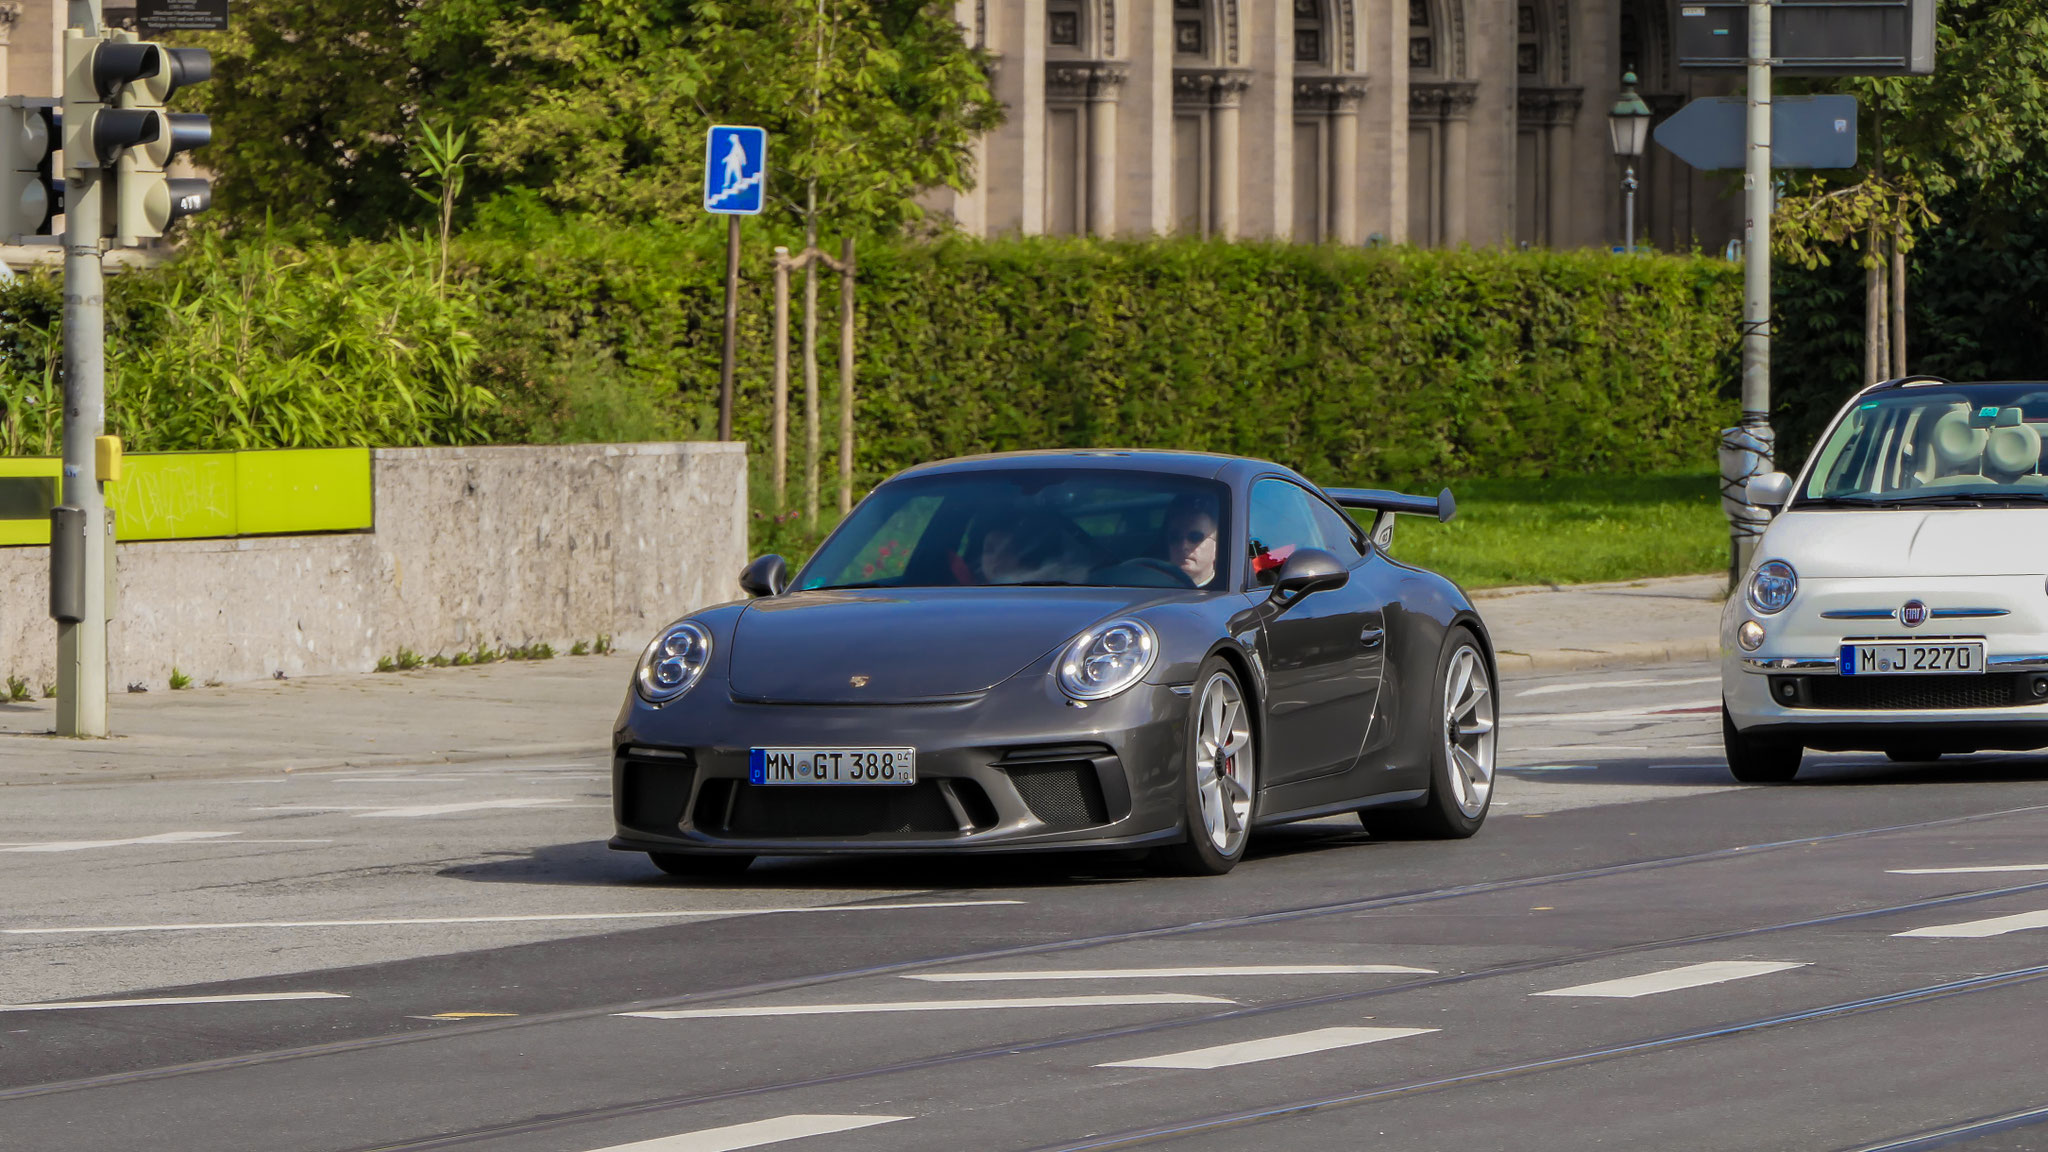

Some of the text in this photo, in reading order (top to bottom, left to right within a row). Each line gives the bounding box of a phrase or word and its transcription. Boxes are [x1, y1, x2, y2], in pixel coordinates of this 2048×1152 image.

[1906, 607, 1921, 620] FIAT
[1861, 647, 1970, 671] M J 2270
[1845, 662, 1851, 670] D
[766, 753, 894, 780] MN GT 388
[754, 770, 760, 778] D
[898, 771, 909, 780] 10
